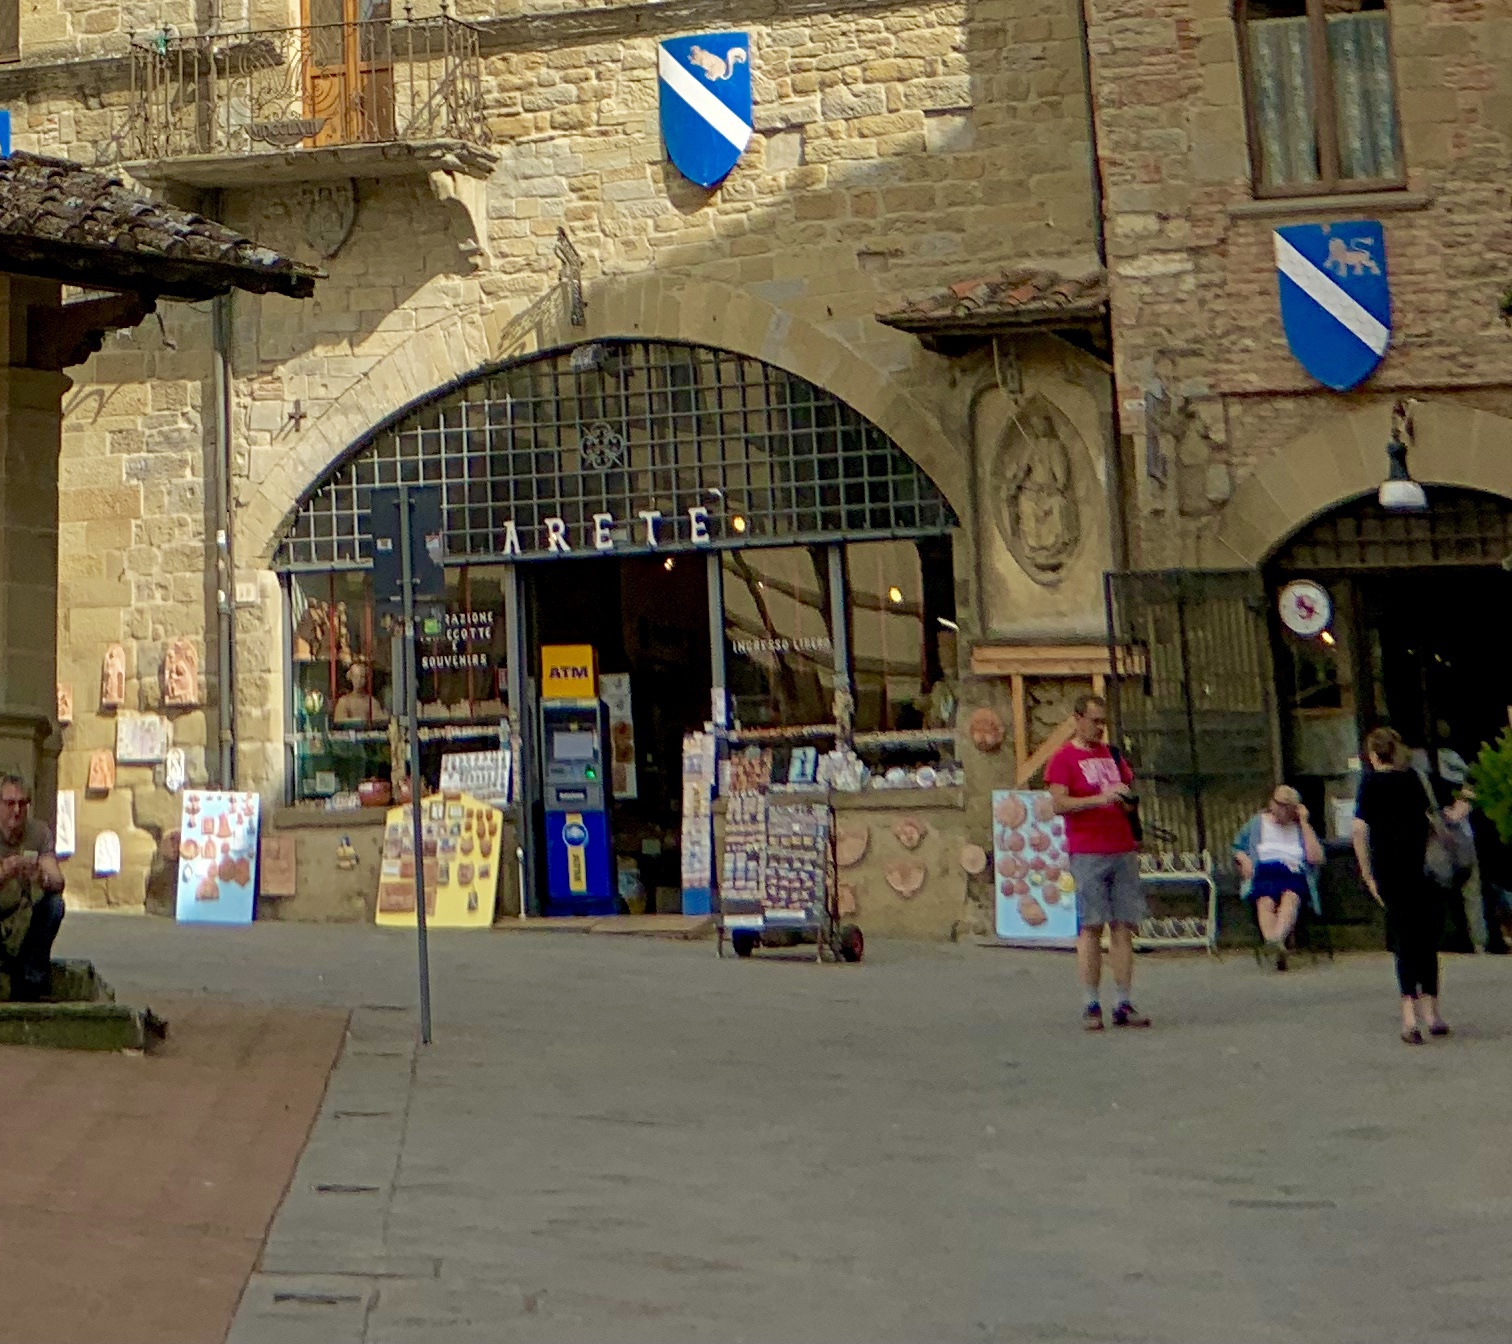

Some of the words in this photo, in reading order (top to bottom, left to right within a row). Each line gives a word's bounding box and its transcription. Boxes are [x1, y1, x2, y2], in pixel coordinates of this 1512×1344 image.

[502, 506, 712, 556] ARETE
[444, 611, 494, 627] RAZIONE
[420, 626, 492, 642] ECOTTE
[732, 638, 789, 653] INGRESSO
[421, 653, 488, 669] SOUVENIRS
[548, 665, 589, 681] ATM
